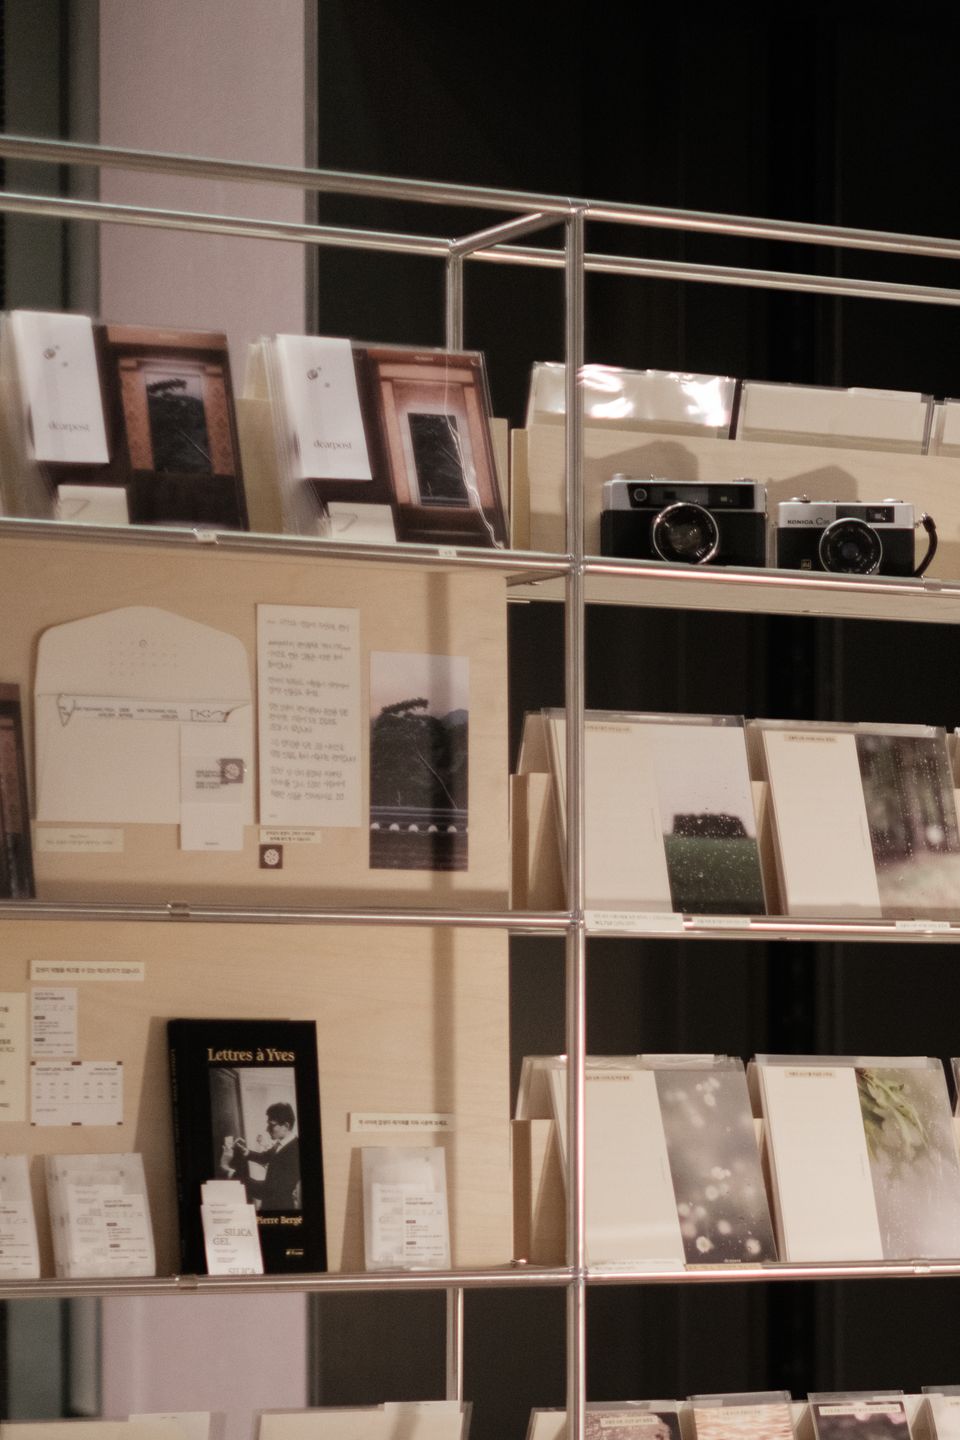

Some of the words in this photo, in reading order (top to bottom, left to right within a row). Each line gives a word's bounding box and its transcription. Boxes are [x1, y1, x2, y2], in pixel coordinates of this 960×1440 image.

[207, 1048, 253, 1062] Lettres
[256, 1048, 264, 1062] à
[266, 1048, 295, 1062] Yves
[256, 1216, 279, 1225] Pierre
[280, 1215, 303, 1227] Bergé
[224, 1228, 253, 1237] SILICA
[212, 1237, 231, 1246] GEL
